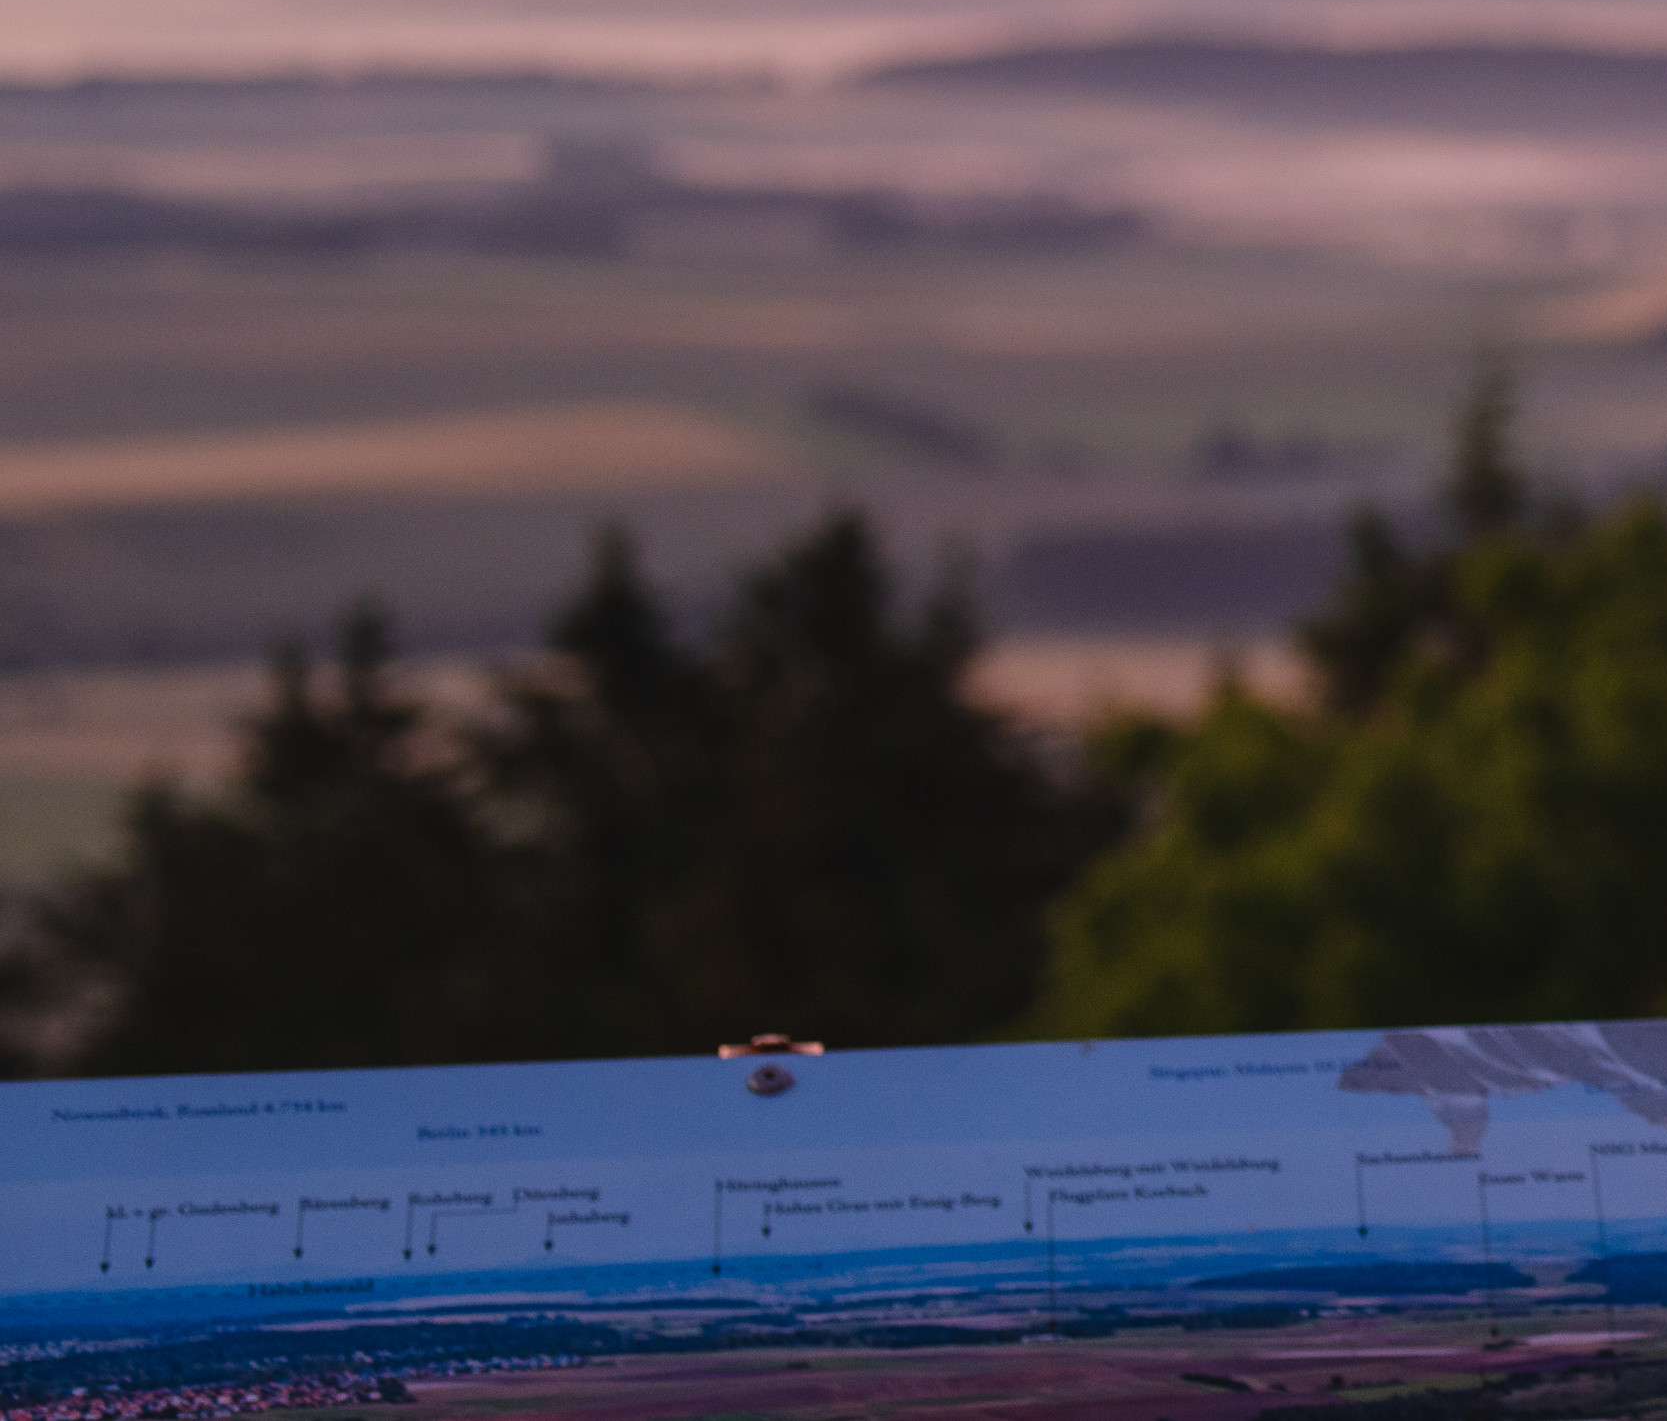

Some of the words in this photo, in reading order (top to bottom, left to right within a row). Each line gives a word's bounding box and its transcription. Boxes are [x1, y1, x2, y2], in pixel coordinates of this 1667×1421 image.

[318, 1098, 346, 1113] km
[417, 1124, 469, 1140] Berlin
[512, 1122, 542, 1136] km
